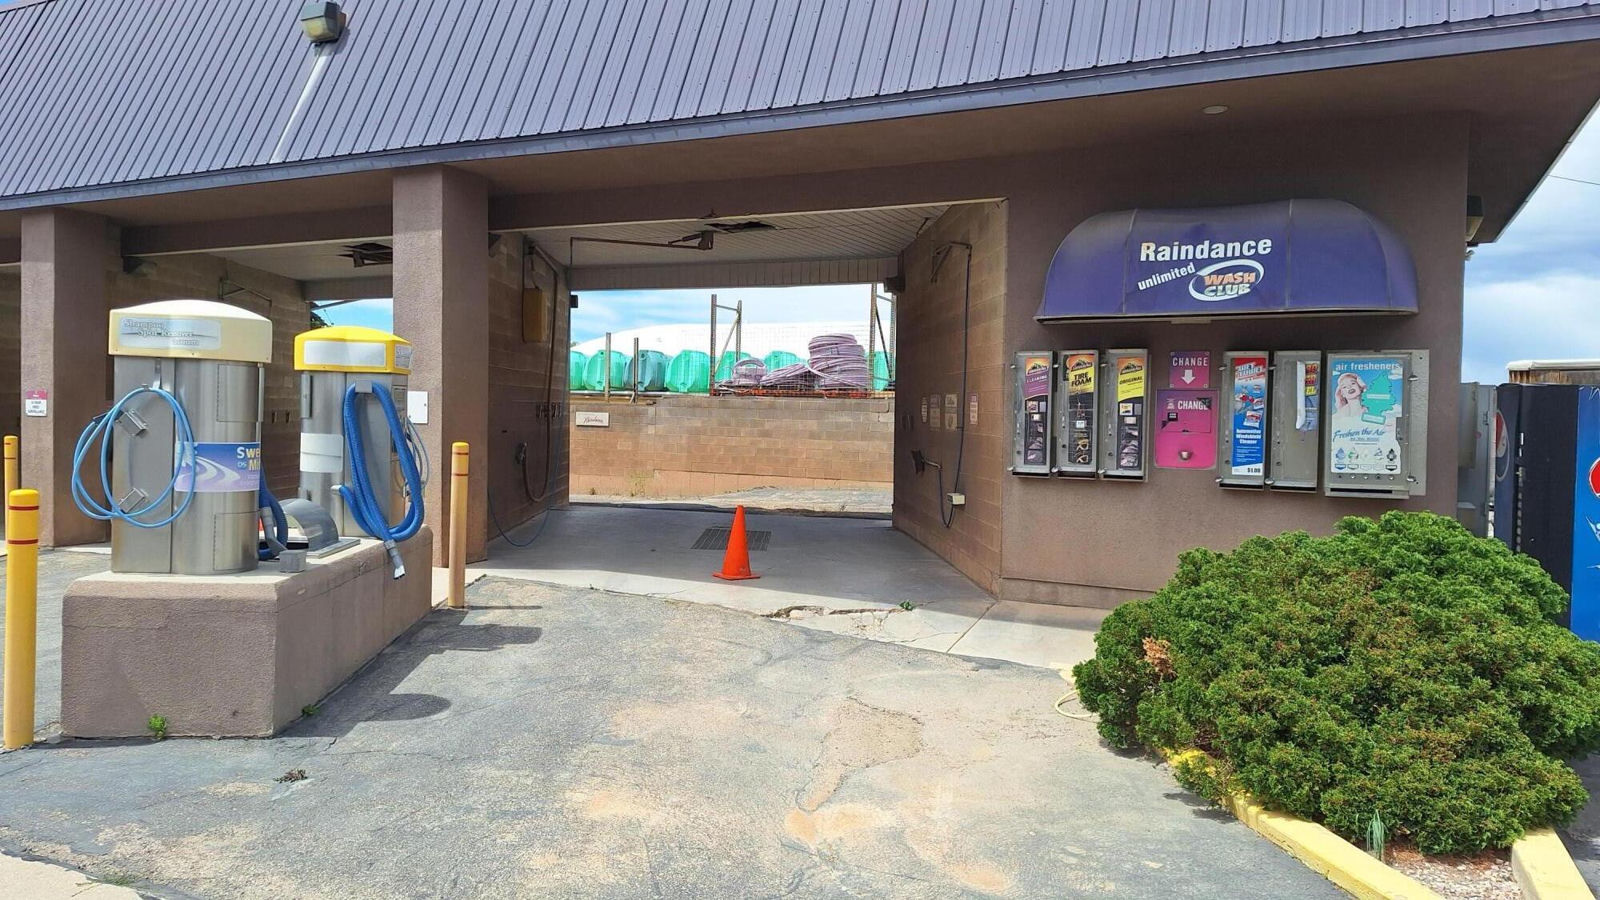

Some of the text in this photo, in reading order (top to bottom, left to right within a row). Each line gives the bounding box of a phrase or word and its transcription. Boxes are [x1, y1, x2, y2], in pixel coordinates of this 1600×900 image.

[1140, 238, 1272, 262] Raindance
[1137, 262, 1196, 291] unlimited
[1203, 271, 1256, 286] WASH
[1204, 283, 1251, 297] CLUB
[1172, 357, 1209, 367] CHANGE
[1335, 361, 1400, 371] air fresheners
[1071, 377, 1092, 387] FOAM
[1074, 371, 1089, 379] TIRE
[1332, 429, 1360, 442] Freshen
[1361, 427, 1371, 436] the
